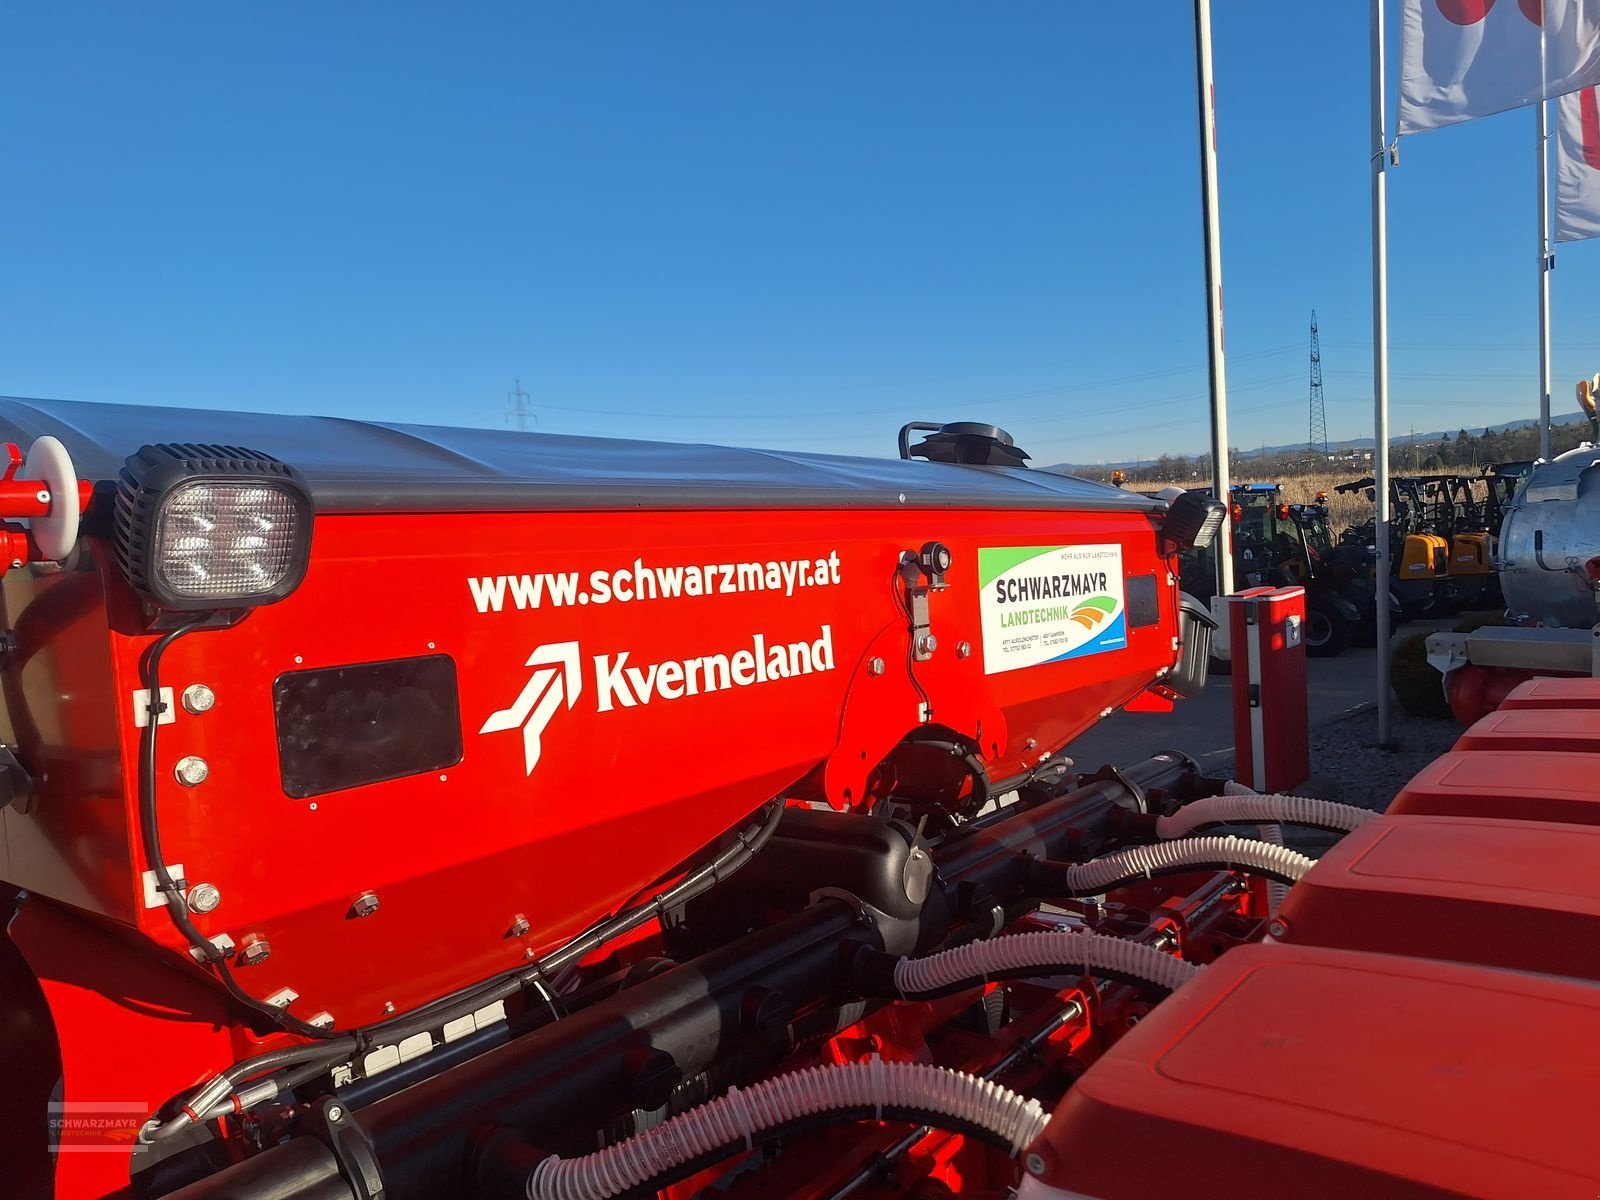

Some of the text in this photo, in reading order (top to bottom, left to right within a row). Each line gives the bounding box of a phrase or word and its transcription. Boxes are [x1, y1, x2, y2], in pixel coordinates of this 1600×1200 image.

[467, 549, 841, 613] www.schwarzmayr.at
[996, 572, 1107, 604] SCHWARZMAYR
[1000, 605, 1069, 628] LANDTECHNIK
[593, 624, 835, 713] Kverneland
